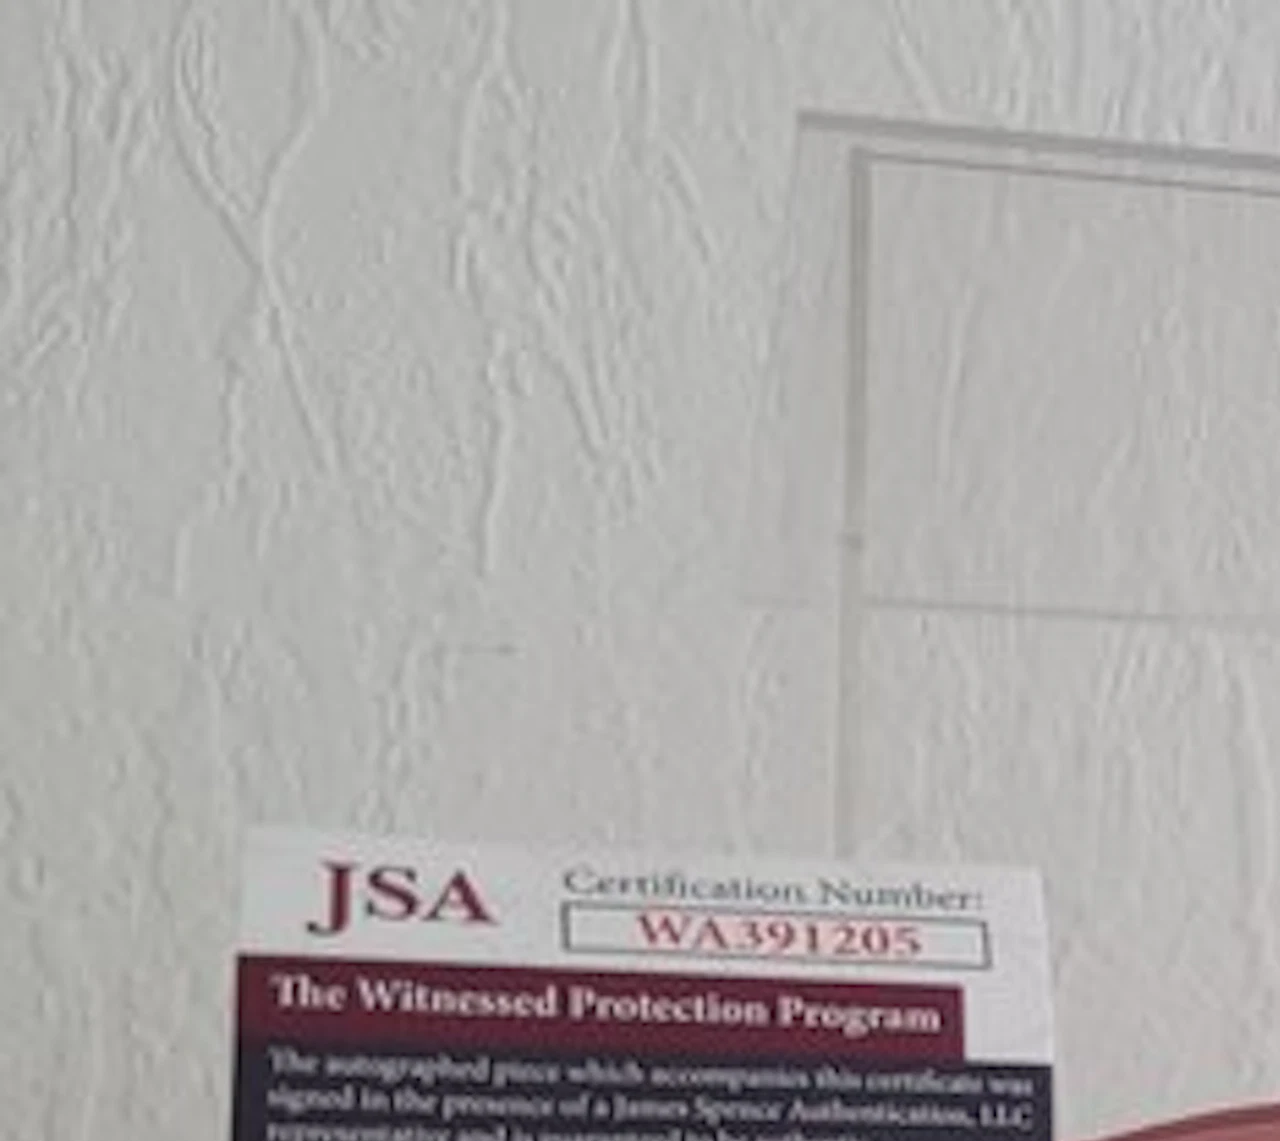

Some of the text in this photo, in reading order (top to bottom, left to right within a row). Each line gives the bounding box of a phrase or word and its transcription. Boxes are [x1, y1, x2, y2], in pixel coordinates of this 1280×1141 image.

[307, 860, 499, 937] JSA
[562, 868, 988, 912] Certification Number:
[635, 913, 923, 957] WA391205
[271, 973, 942, 1039] The Witnessed Protection Program
